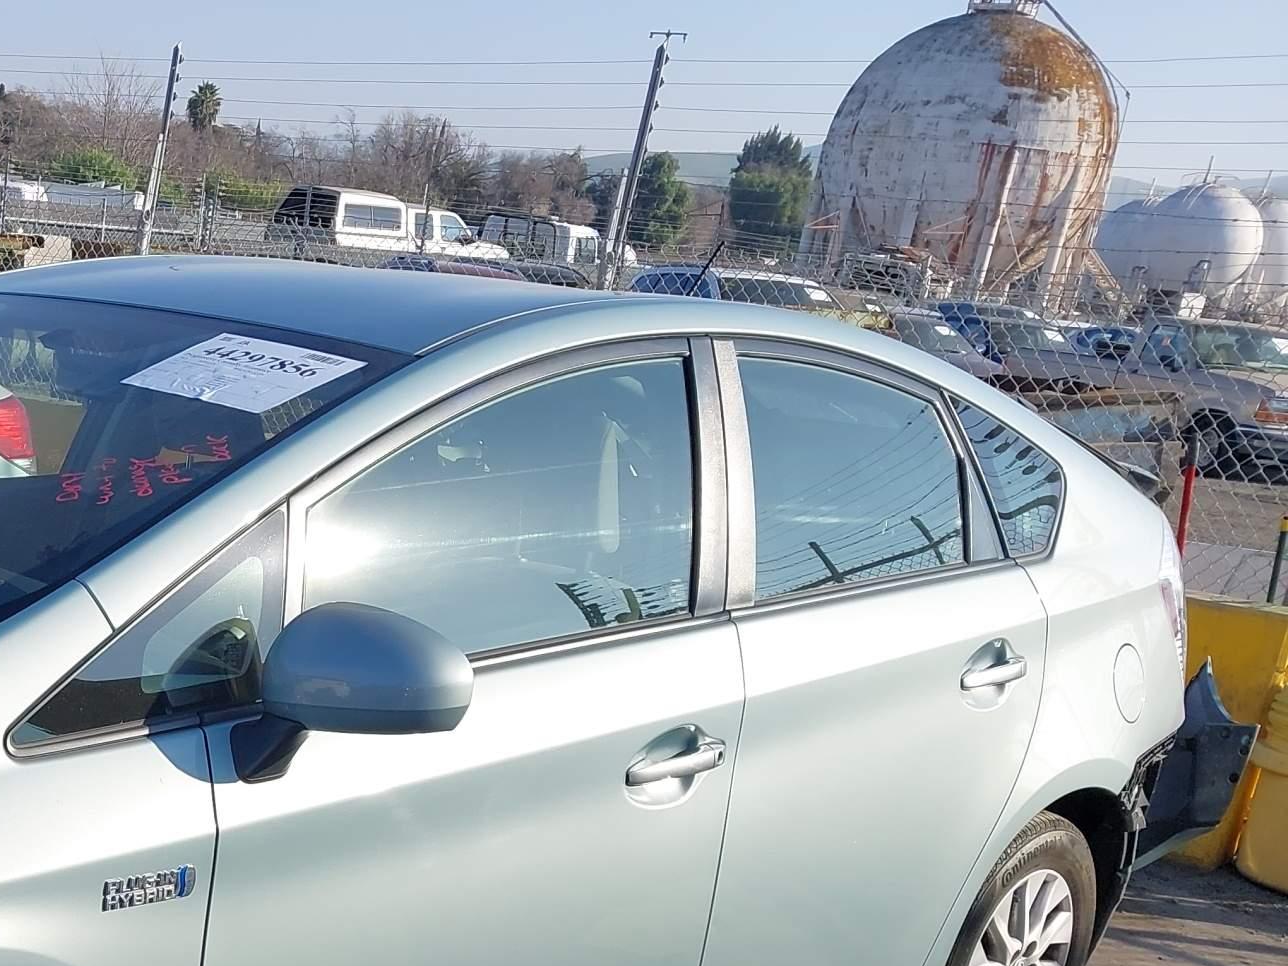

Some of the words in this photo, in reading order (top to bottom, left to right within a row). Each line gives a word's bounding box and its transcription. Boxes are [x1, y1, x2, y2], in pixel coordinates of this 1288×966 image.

[202, 345, 326, 378] 44297856
[103, 868, 177, 897] PLUG-IN
[102, 884, 177, 912] HYBRID
